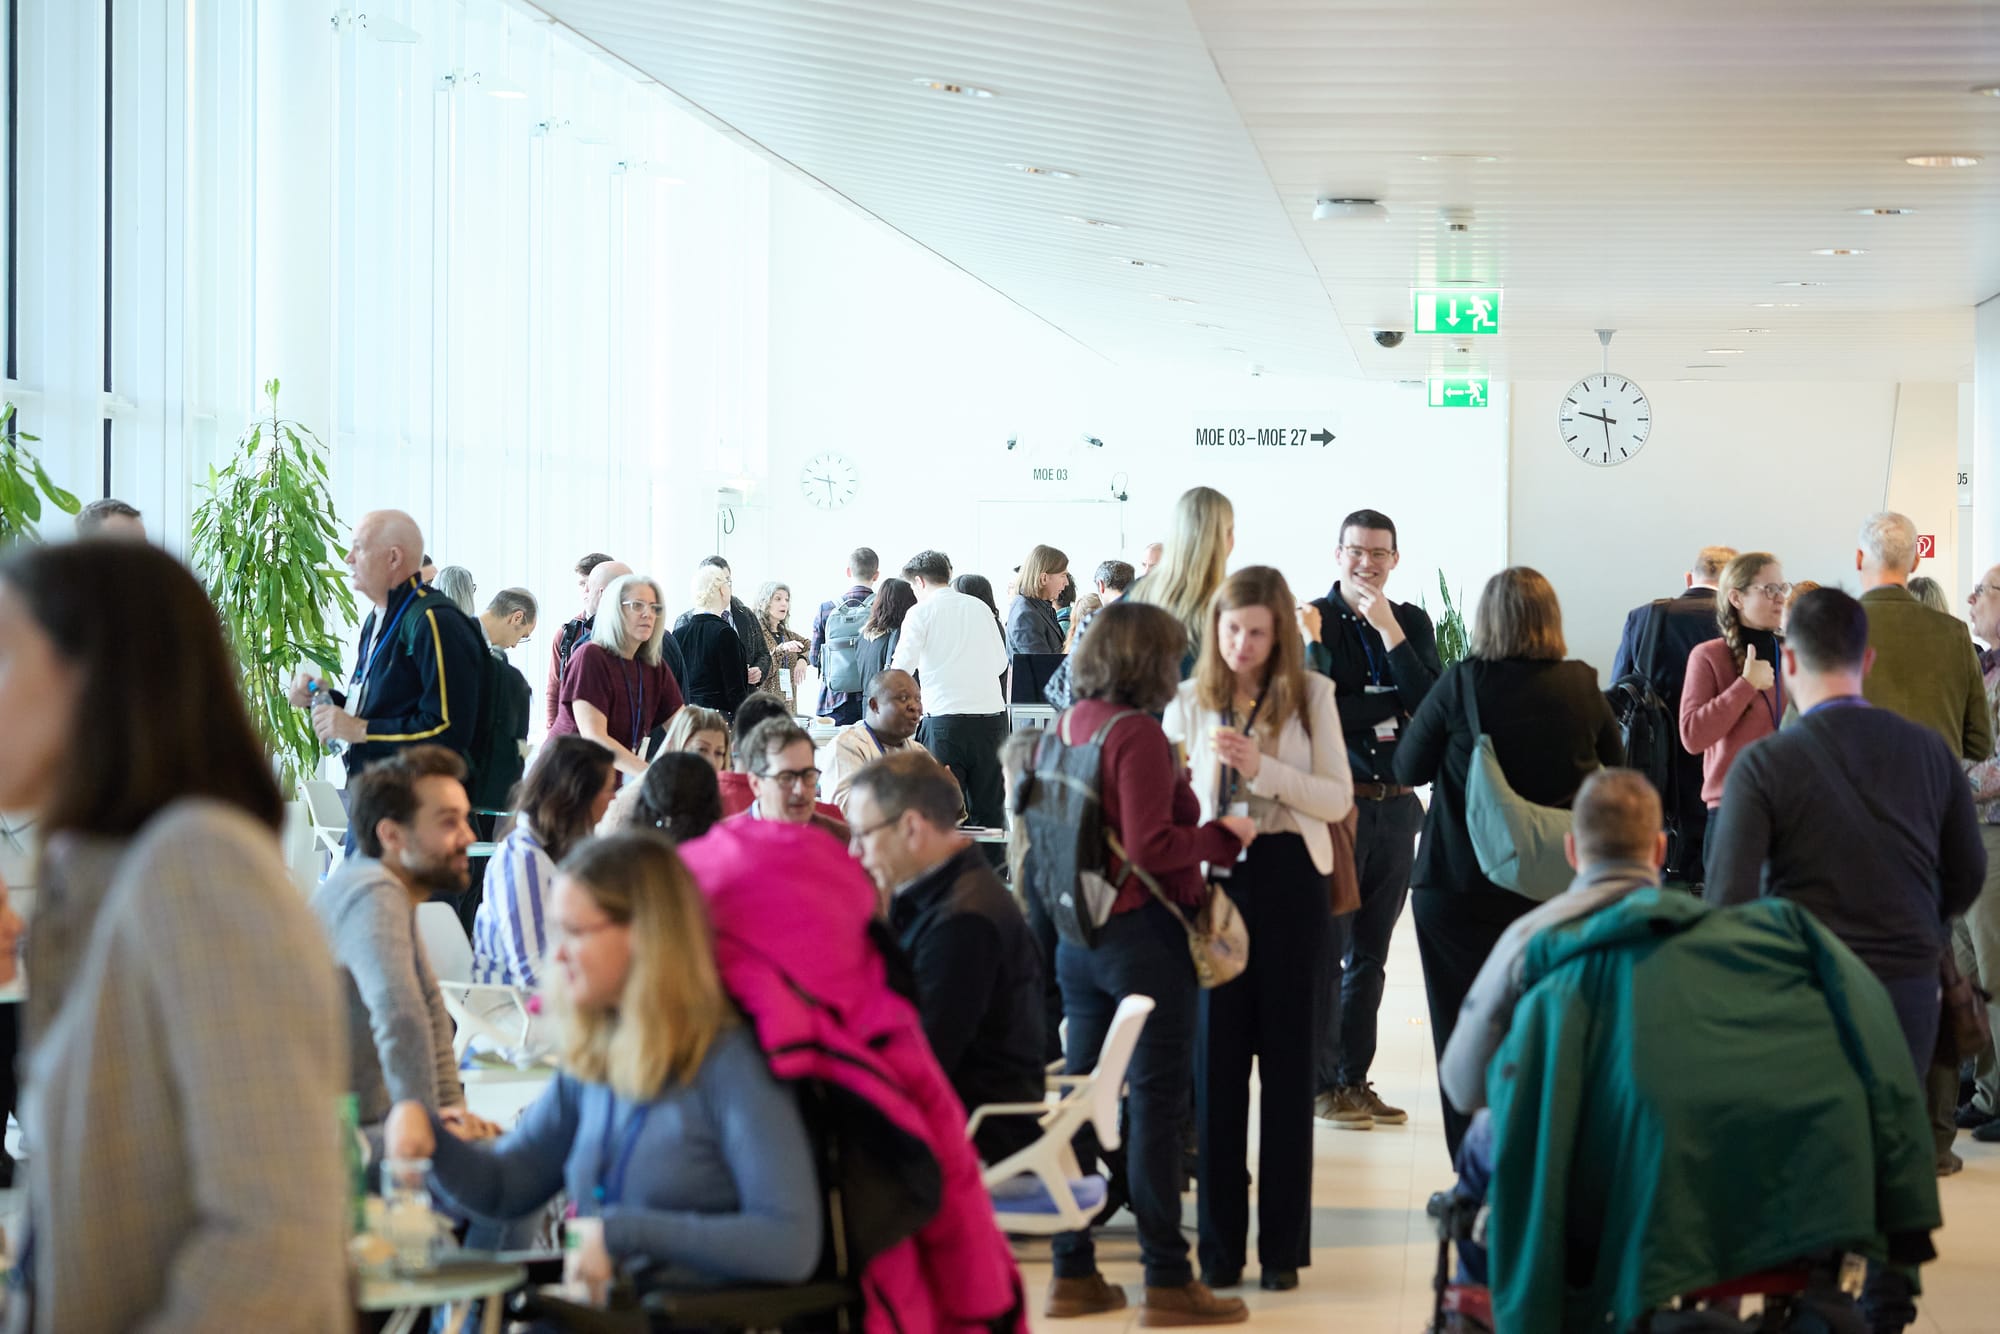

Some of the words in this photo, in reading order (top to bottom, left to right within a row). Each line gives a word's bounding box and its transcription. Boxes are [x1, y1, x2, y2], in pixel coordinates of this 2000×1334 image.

[1196, 428, 1225, 446] MOE
[1290, 428, 1307, 446] 27
[1033, 468, 1054, 480] MOE
[1056, 468, 1068, 480] 03
